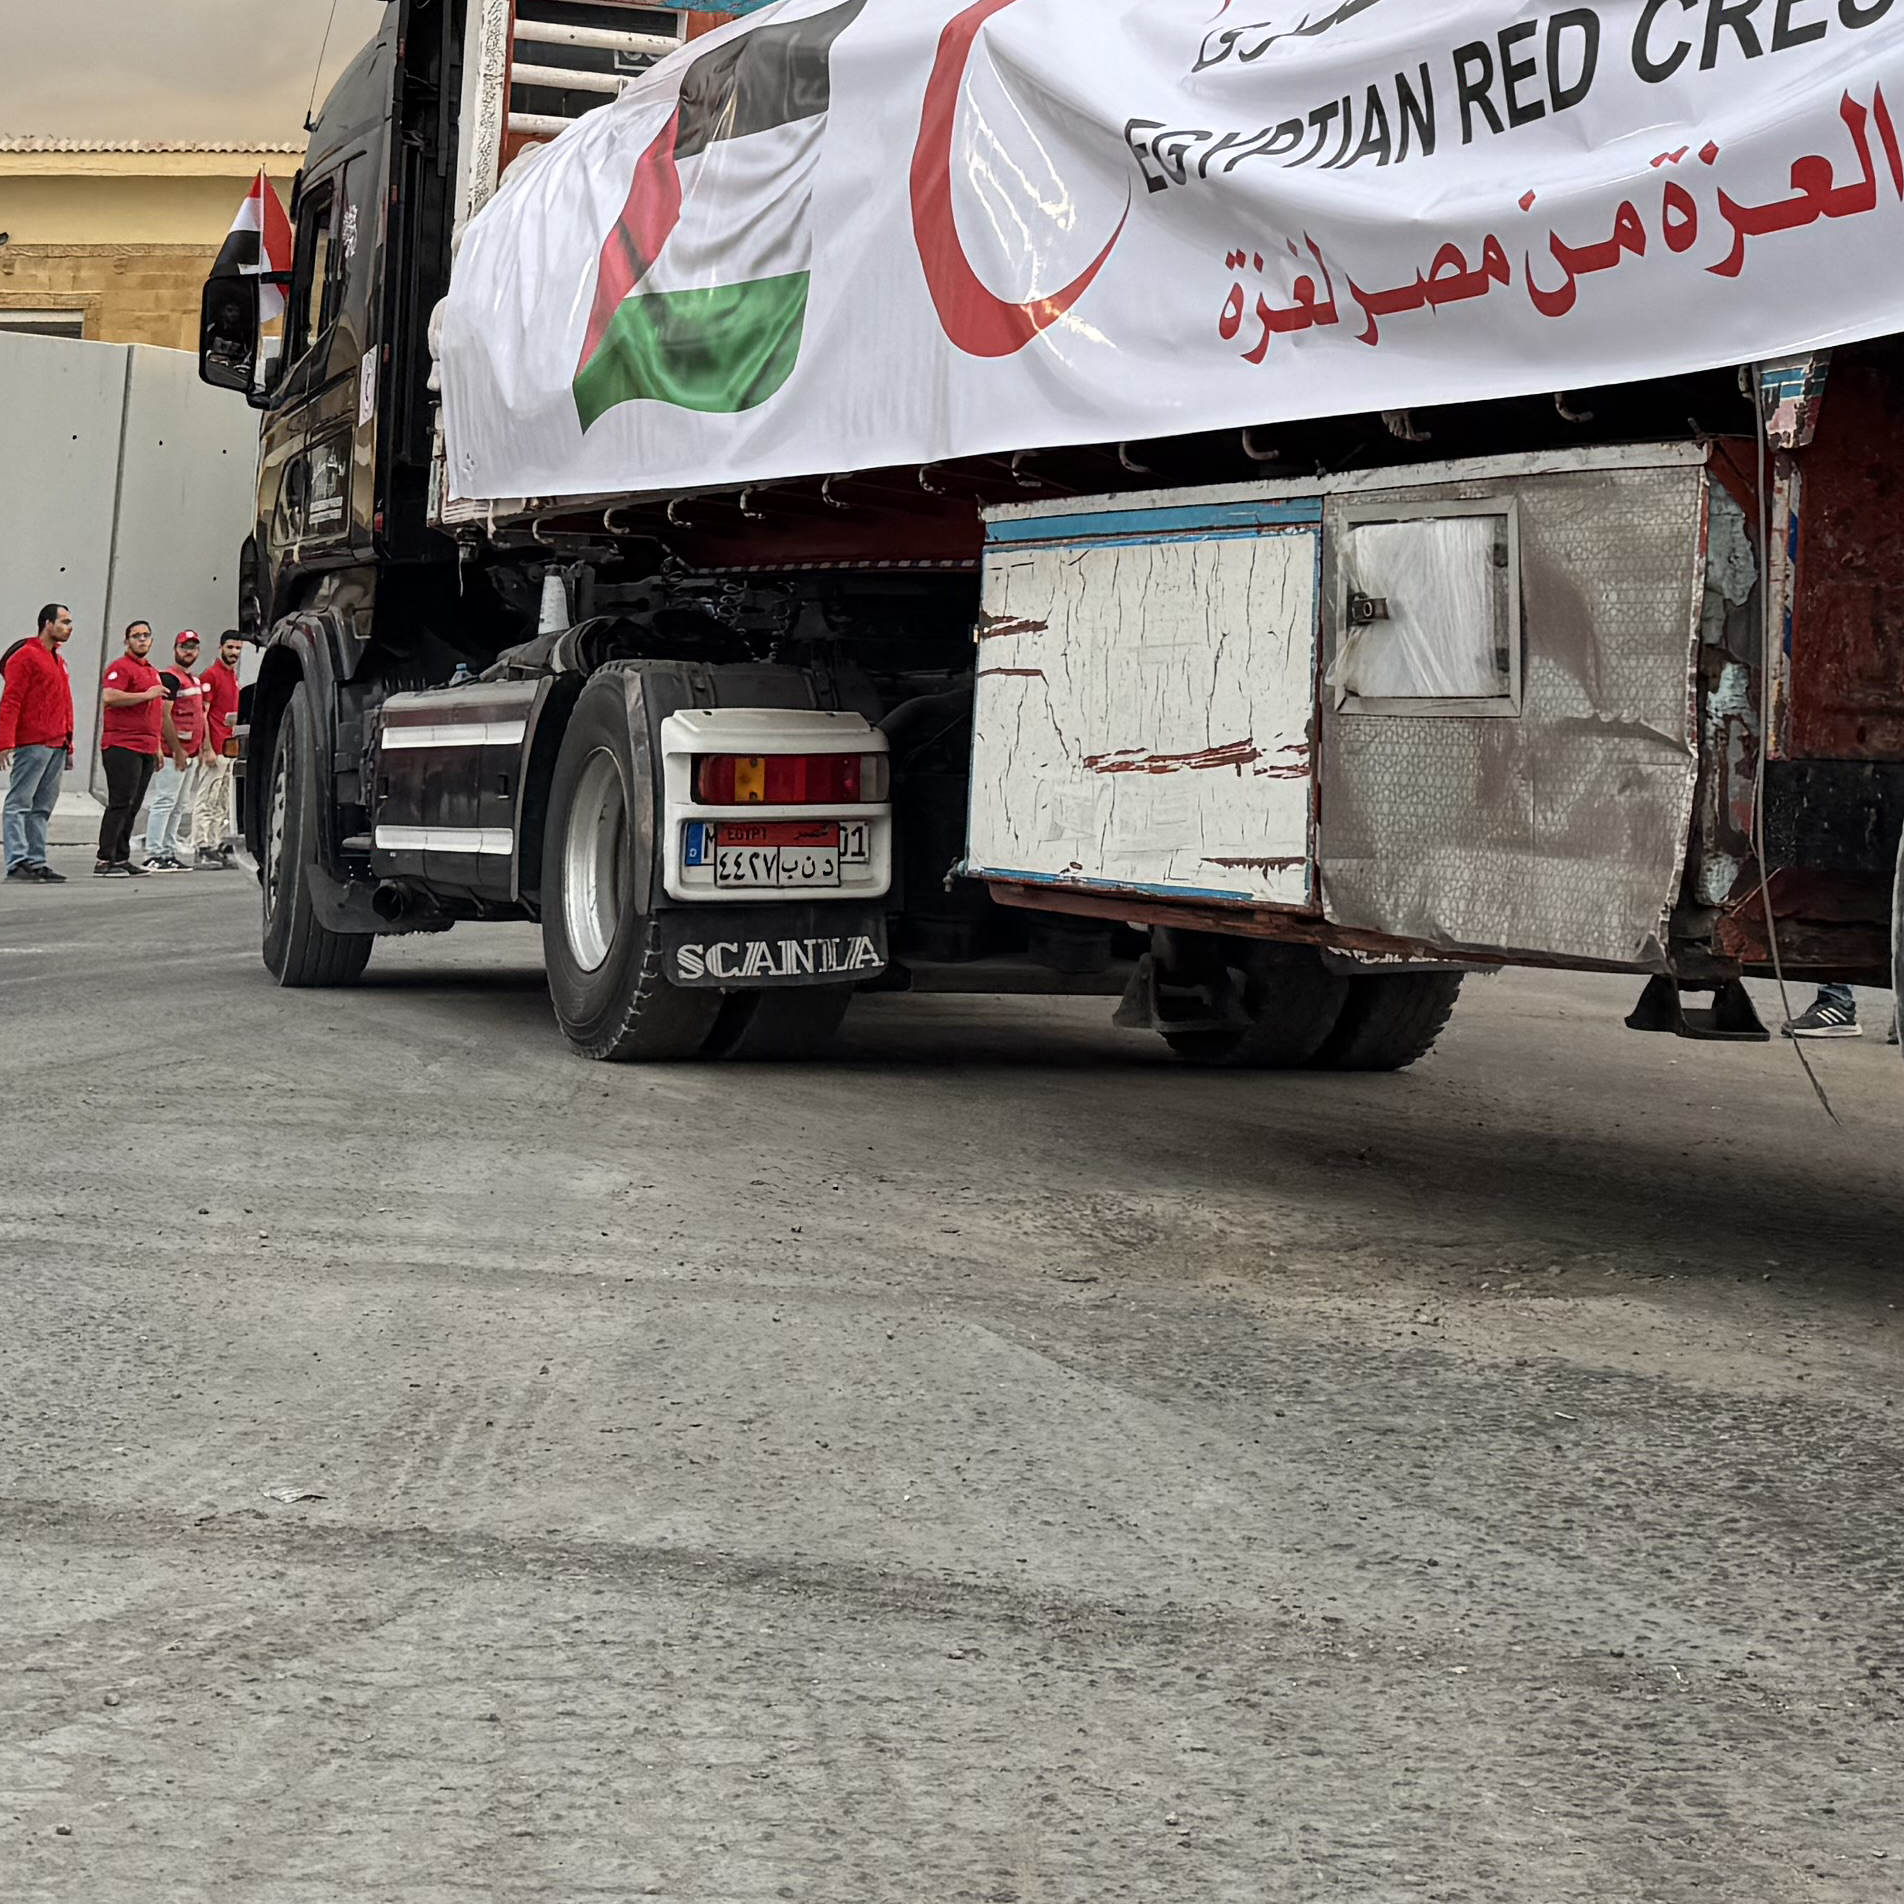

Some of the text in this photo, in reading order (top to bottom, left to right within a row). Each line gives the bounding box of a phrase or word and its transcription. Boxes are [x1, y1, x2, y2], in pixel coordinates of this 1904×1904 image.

[1123, 61, 1437, 194] EGYPTIAN
[1452, 7, 1600, 145] RED
[1218, 229, 1339, 365] لغزة
[1346, 232, 1511, 347] مصر
[1524, 189, 1647, 318] من
[676, 935, 886, 980] SCANIA
